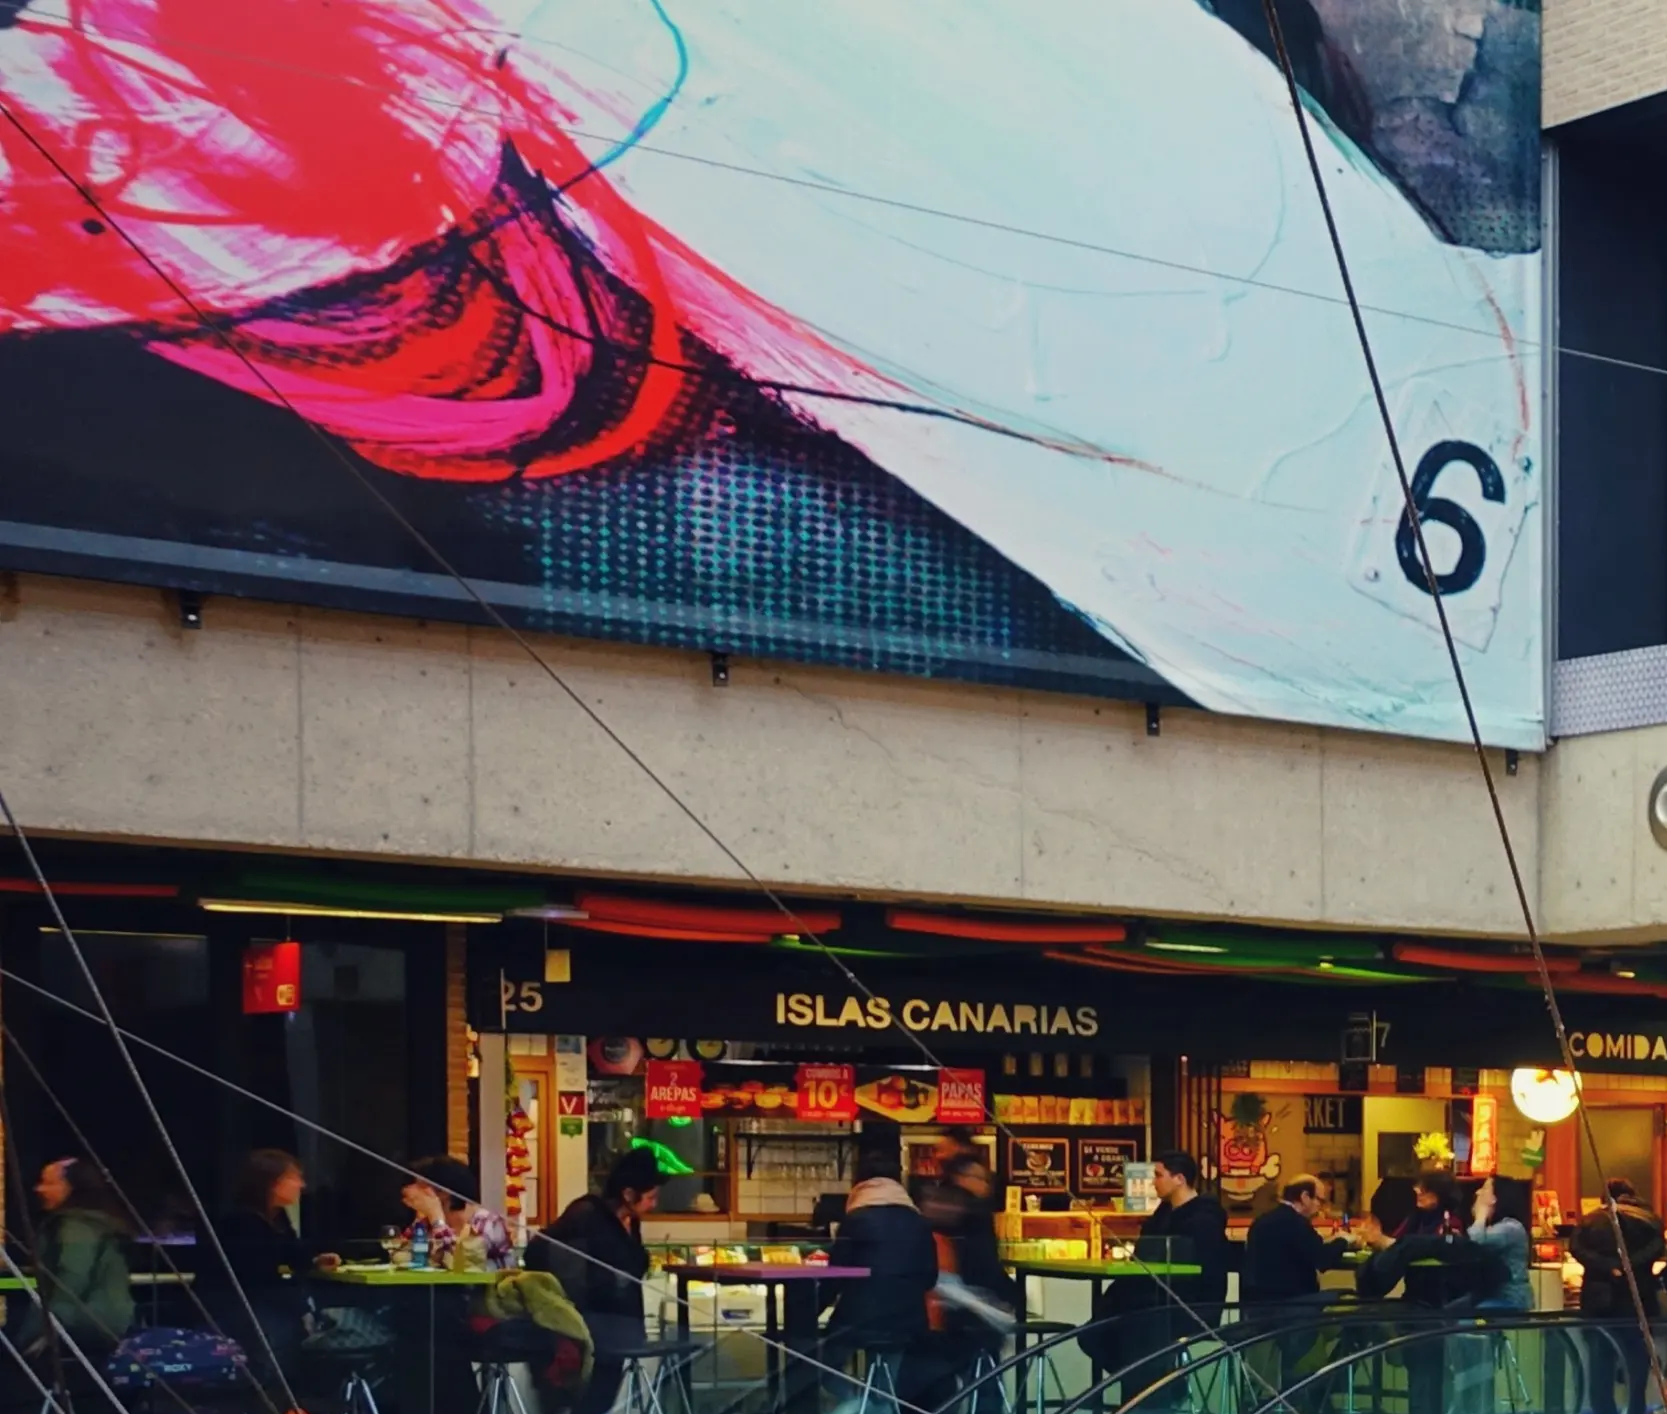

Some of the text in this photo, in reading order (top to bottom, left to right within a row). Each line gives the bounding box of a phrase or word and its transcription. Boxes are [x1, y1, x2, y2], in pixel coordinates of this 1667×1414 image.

[1395, 439, 1506, 596] 6
[503, 981, 543, 1012] 25
[776, 993, 1098, 1037] ISLAS CANARIAS
[651, 1086, 697, 1102] AREPAS
[941, 1082, 982, 1100] PAPAS
